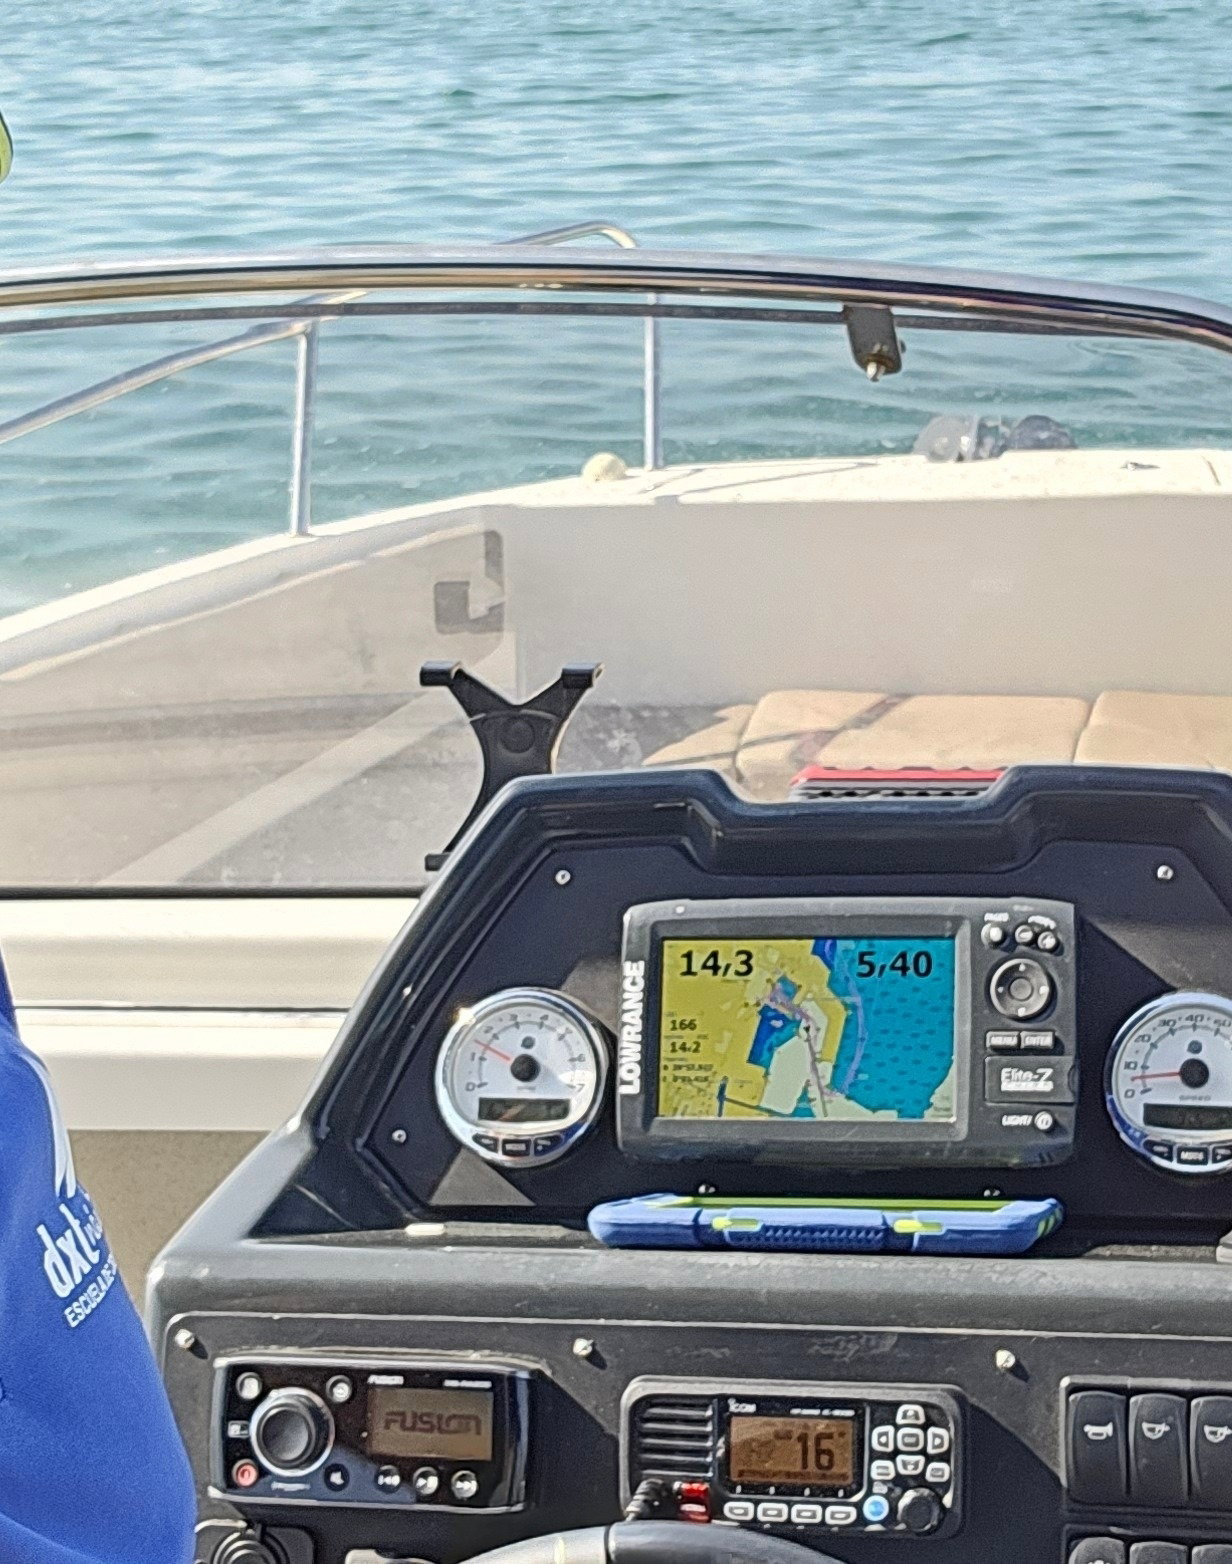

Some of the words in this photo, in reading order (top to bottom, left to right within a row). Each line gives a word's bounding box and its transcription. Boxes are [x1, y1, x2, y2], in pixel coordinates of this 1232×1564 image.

[855, 950, 933, 979] 5,40
[1157, 1019, 1177, 1028] 30
[1185, 1014, 1204, 1023] 40
[1213, 1018, 1232, 1027] 50
[618, 960, 645, 1095] LOWRANCE
[670, 1018, 698, 1032] 166
[1134, 1034, 1152, 1044] 20
[1123, 1061, 1138, 1070] 10
[797, 1431, 836, 1471] 16
